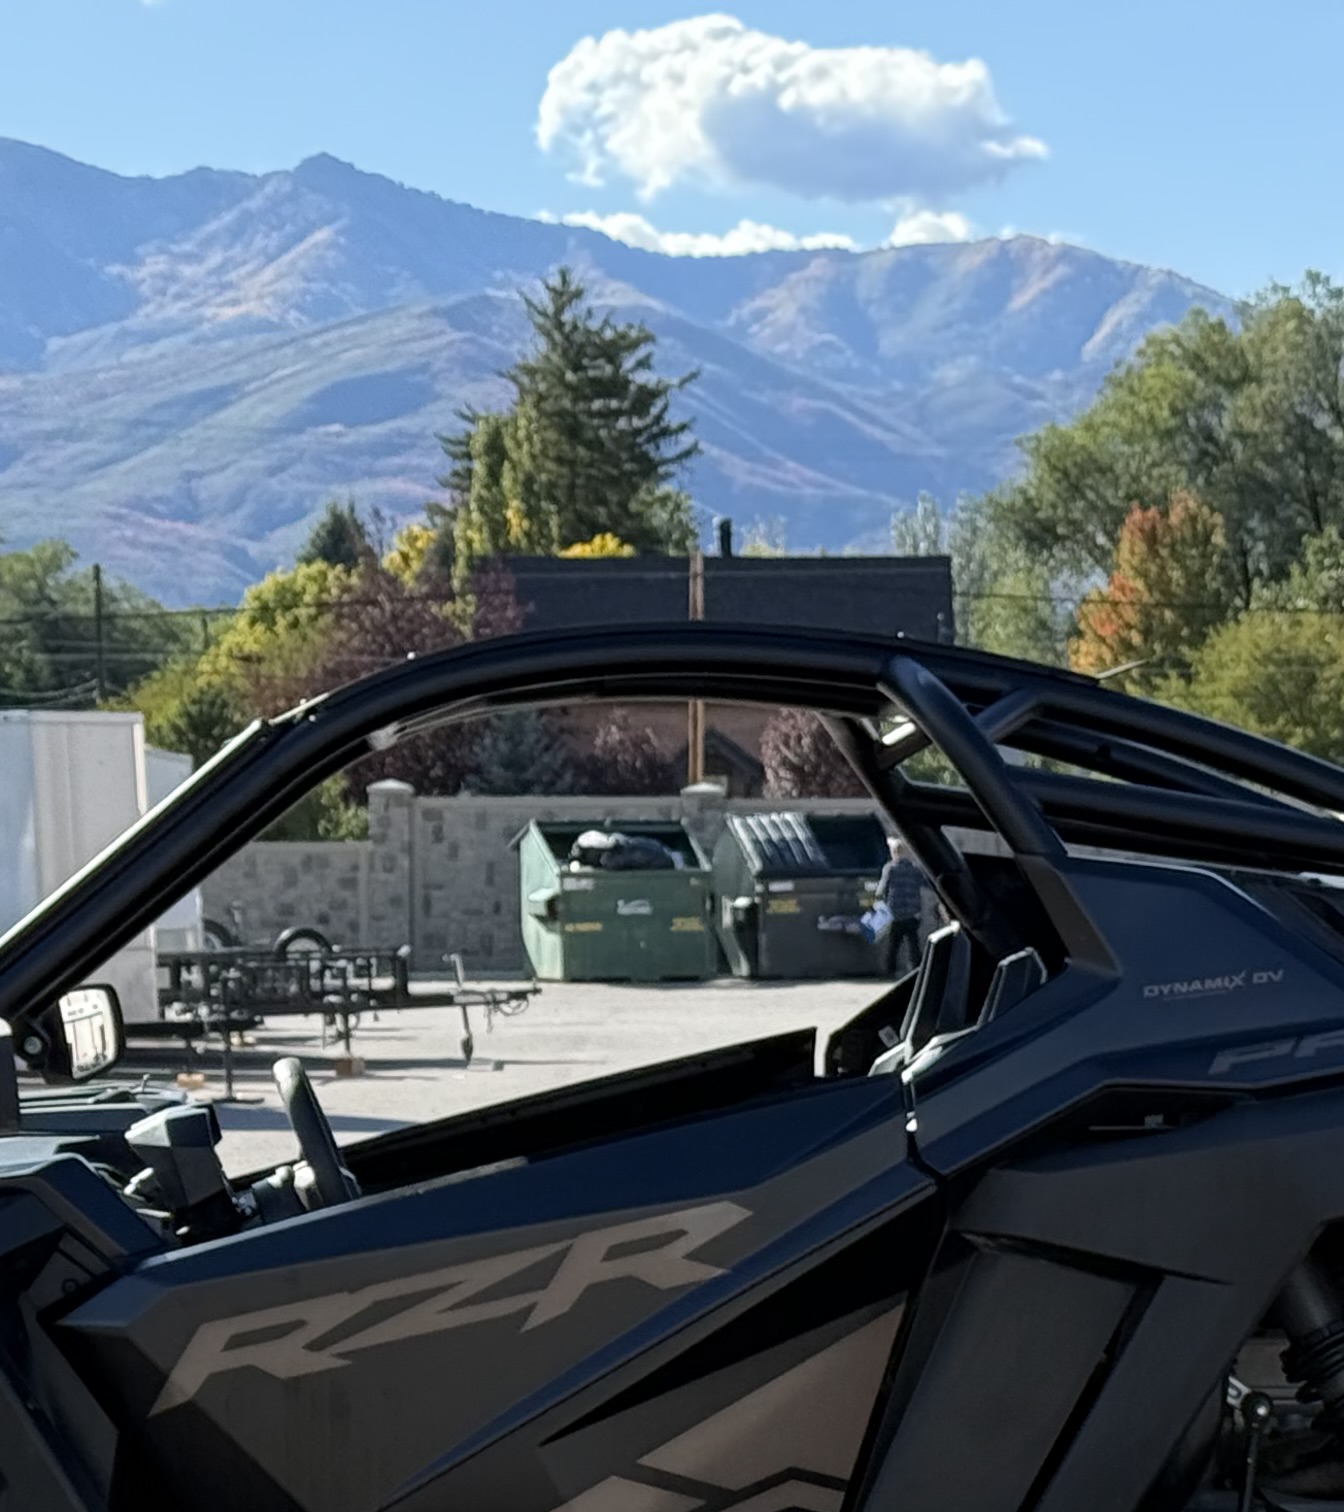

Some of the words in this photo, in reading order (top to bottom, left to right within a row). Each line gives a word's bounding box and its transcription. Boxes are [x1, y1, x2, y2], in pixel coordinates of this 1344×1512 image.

[1142, 970, 1248, 998] DYNAMIX
[1252, 969, 1285, 985] DV
[148, 1200, 754, 1418] RZR
